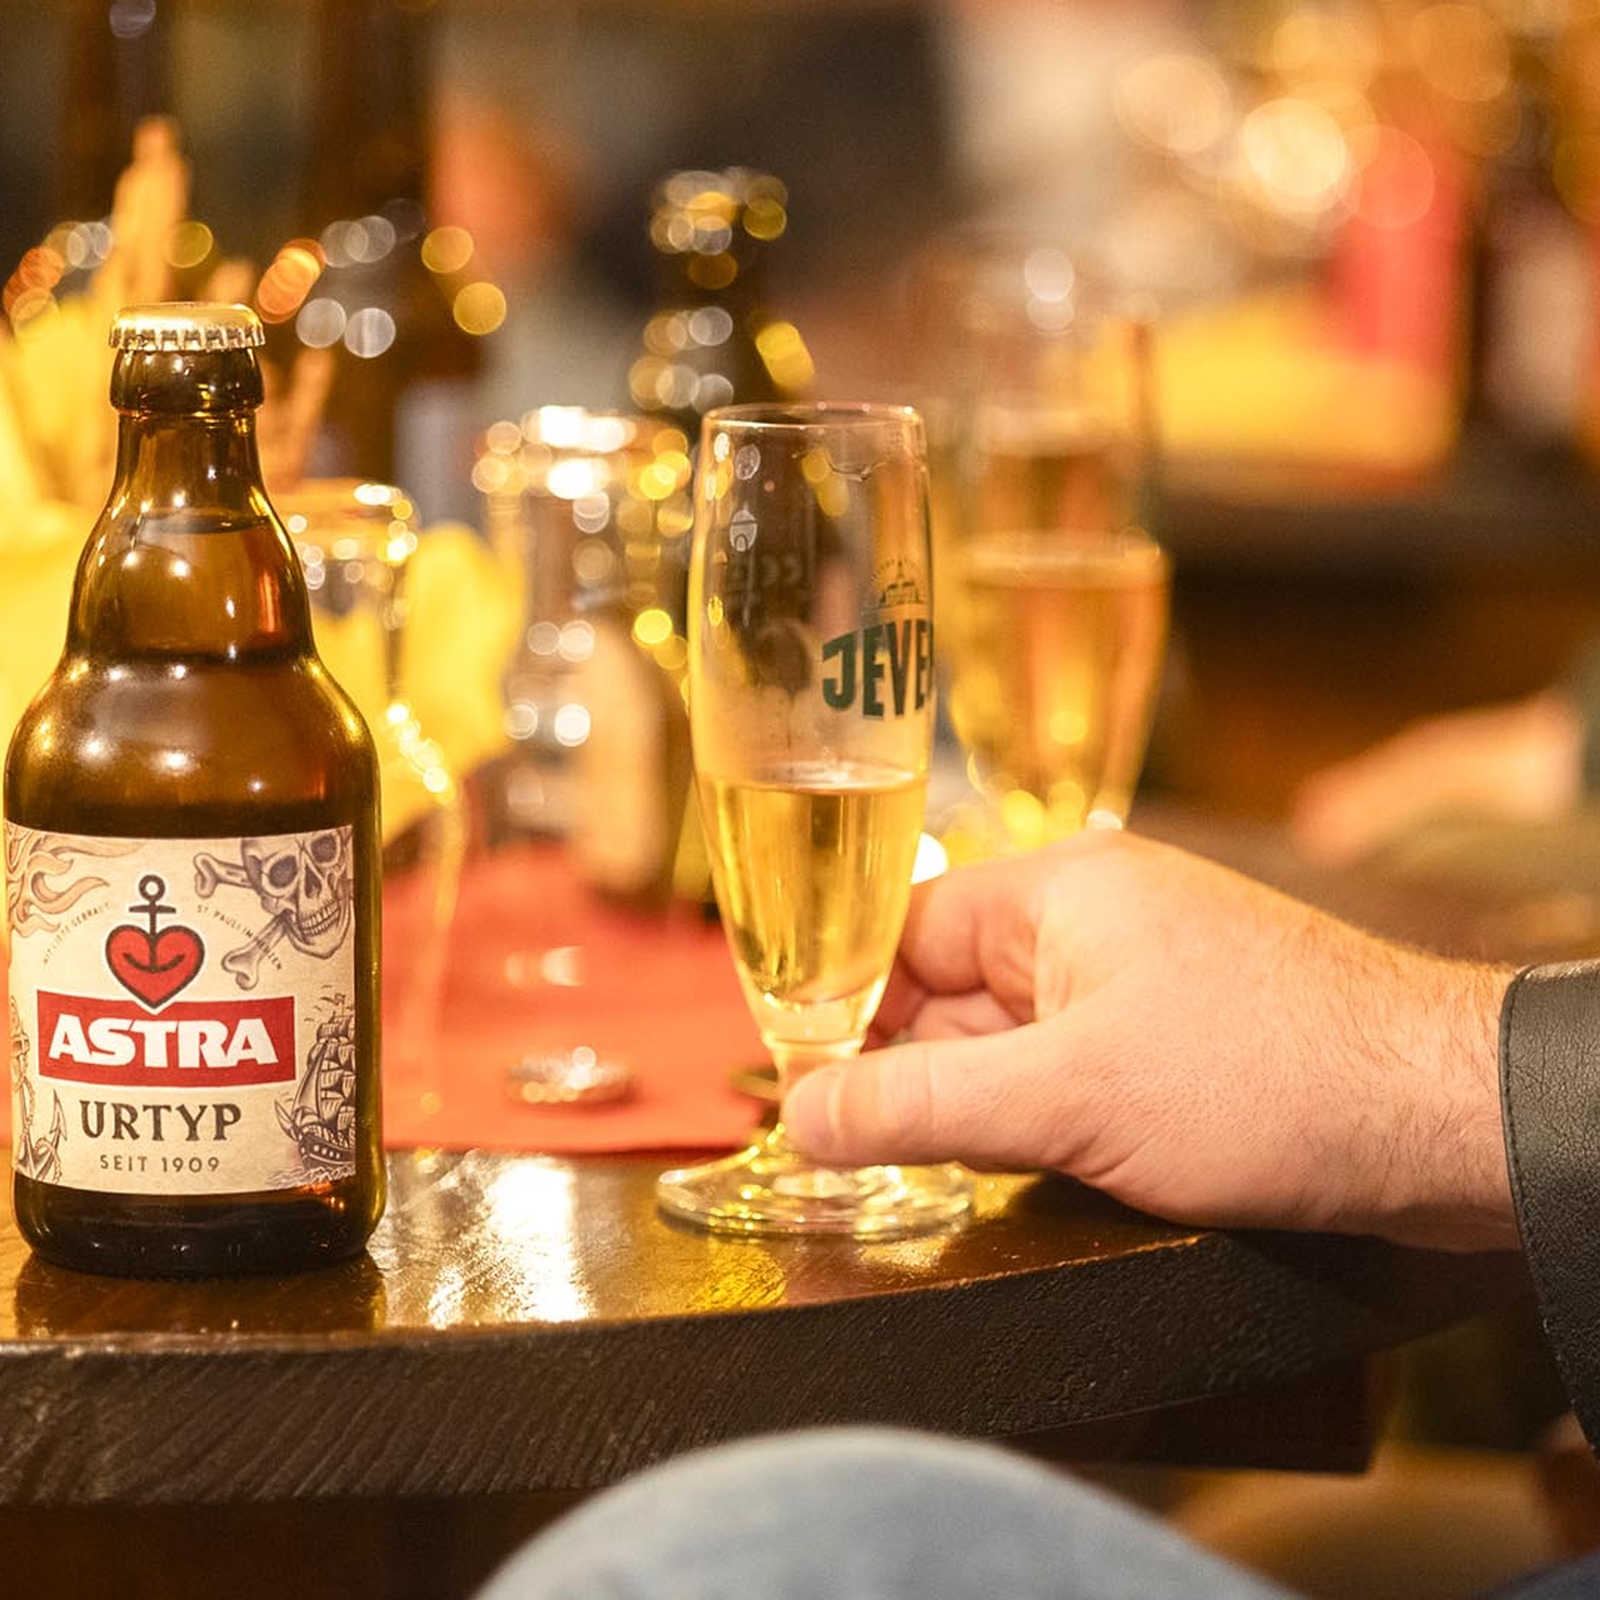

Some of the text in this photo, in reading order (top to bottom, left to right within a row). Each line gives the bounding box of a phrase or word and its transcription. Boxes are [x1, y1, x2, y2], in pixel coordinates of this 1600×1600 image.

[822, 619, 934, 717] JEVE
[48, 1014, 279, 1069] ASTRA
[80, 1099, 242, 1142] URTYP
[100, 1155, 220, 1173] SEIT 1909
